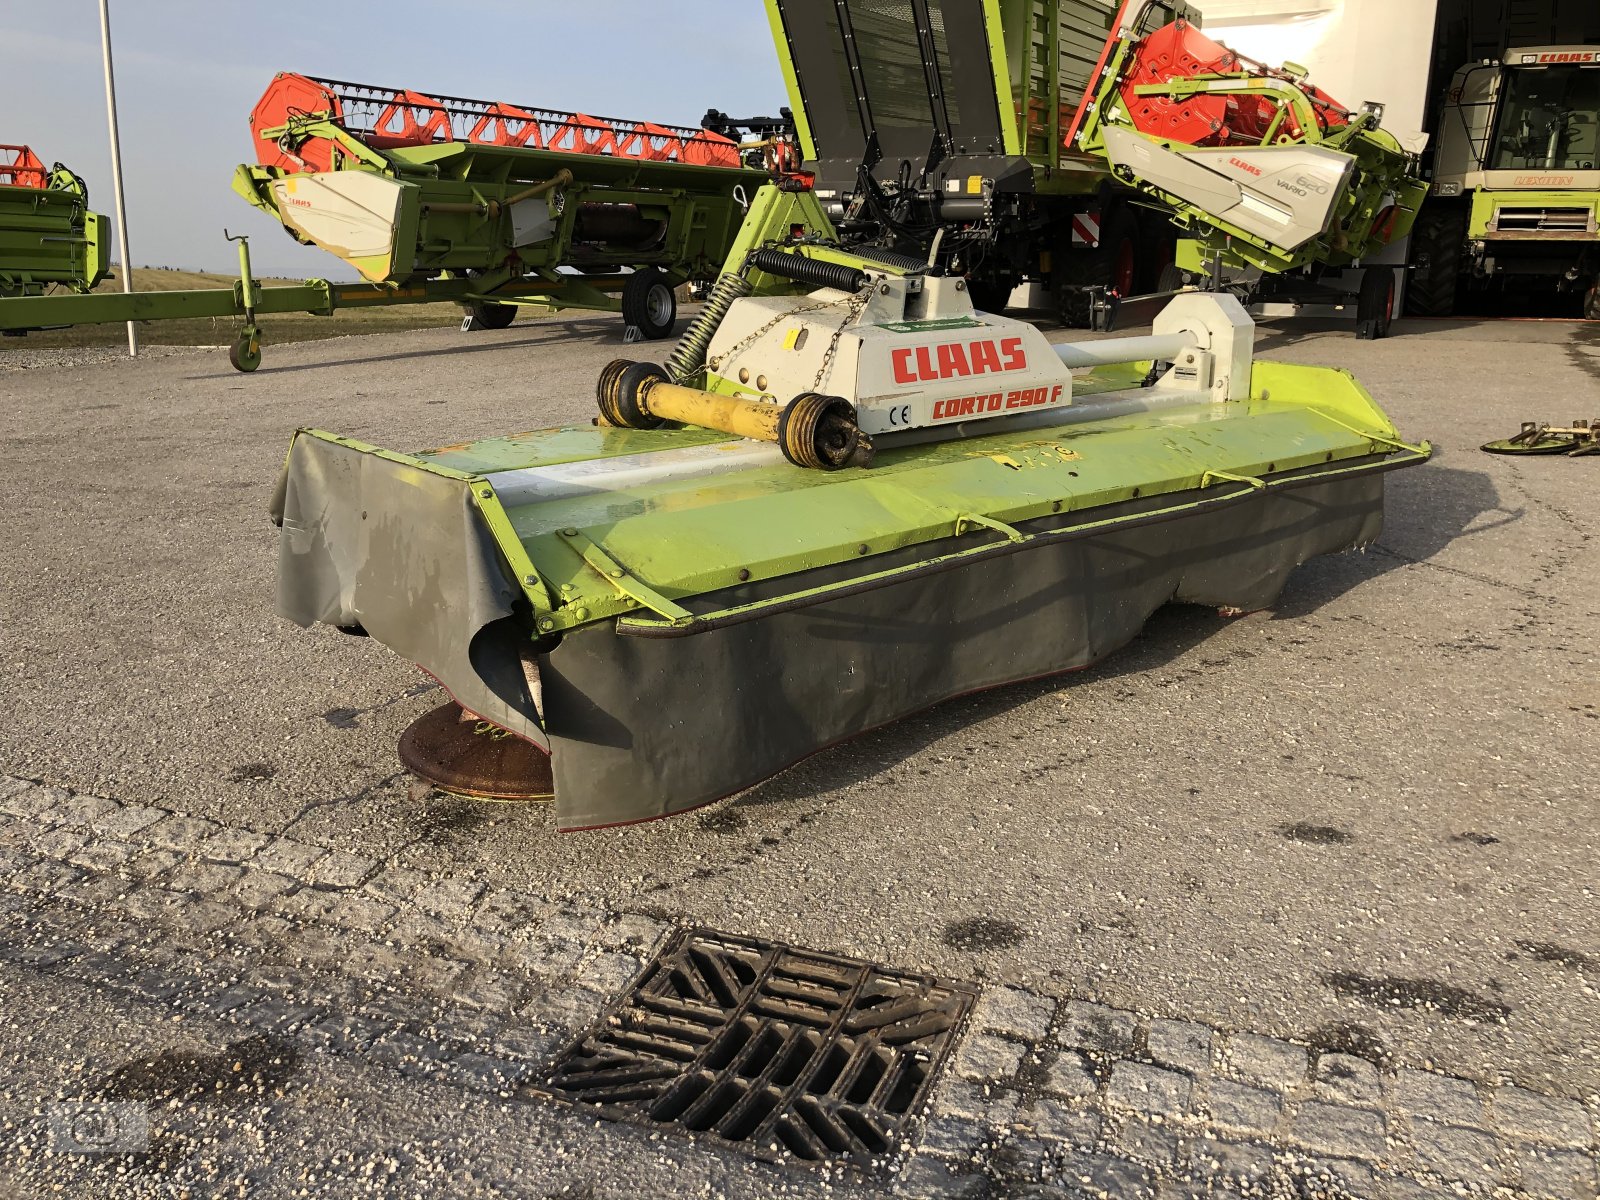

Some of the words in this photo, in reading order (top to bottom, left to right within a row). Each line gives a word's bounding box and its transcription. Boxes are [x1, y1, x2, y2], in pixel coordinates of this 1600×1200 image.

[1540, 53, 1592, 62] CLAAS
[1229, 157, 1262, 176] CLAAS
[1276, 179, 1307, 197] VARIO
[891, 337, 1027, 384] CLAAS
[932, 393, 1003, 420] CORTO
[1005, 387, 1048, 409] 290
[1051, 385, 1063, 403] F
[889, 405, 909, 426] CE
